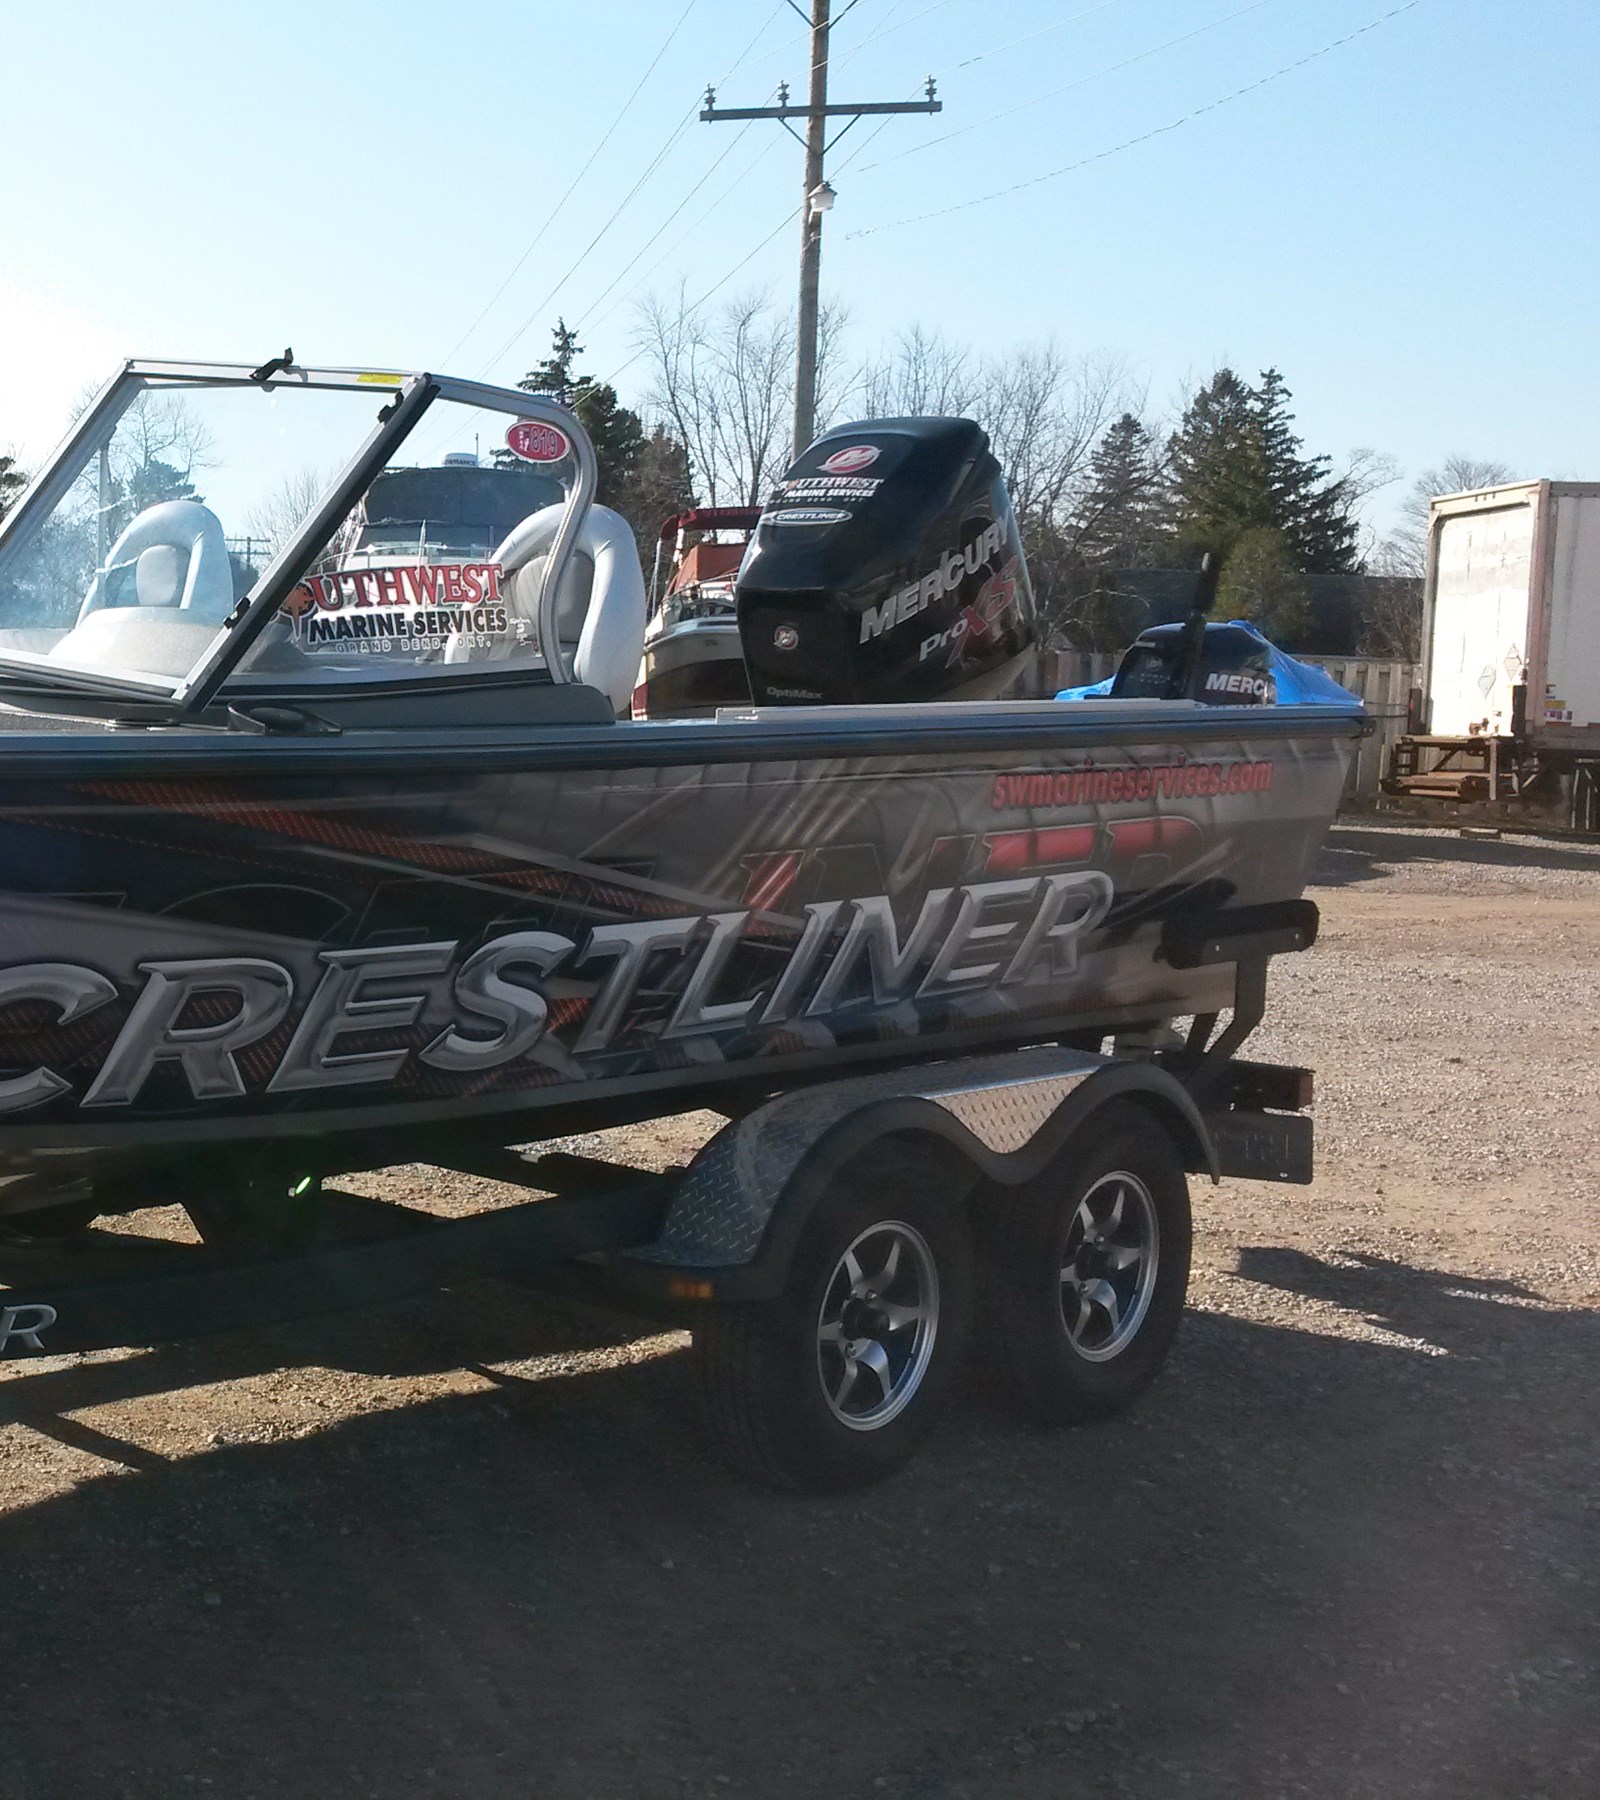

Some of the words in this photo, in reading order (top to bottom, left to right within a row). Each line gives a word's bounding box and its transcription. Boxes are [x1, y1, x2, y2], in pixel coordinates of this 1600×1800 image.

[785, 489, 825, 498] MARINE
[826, 489, 876, 497] SERVICES
[776, 512, 846, 521] CRESTLINER
[859, 511, 1009, 645] MERCURY
[309, 611, 407, 643] MARINE
[413, 608, 507, 636] SERVICES
[335, 640, 391, 654] GRAND
[992, 752, 1273, 811] swmarineservices.com
